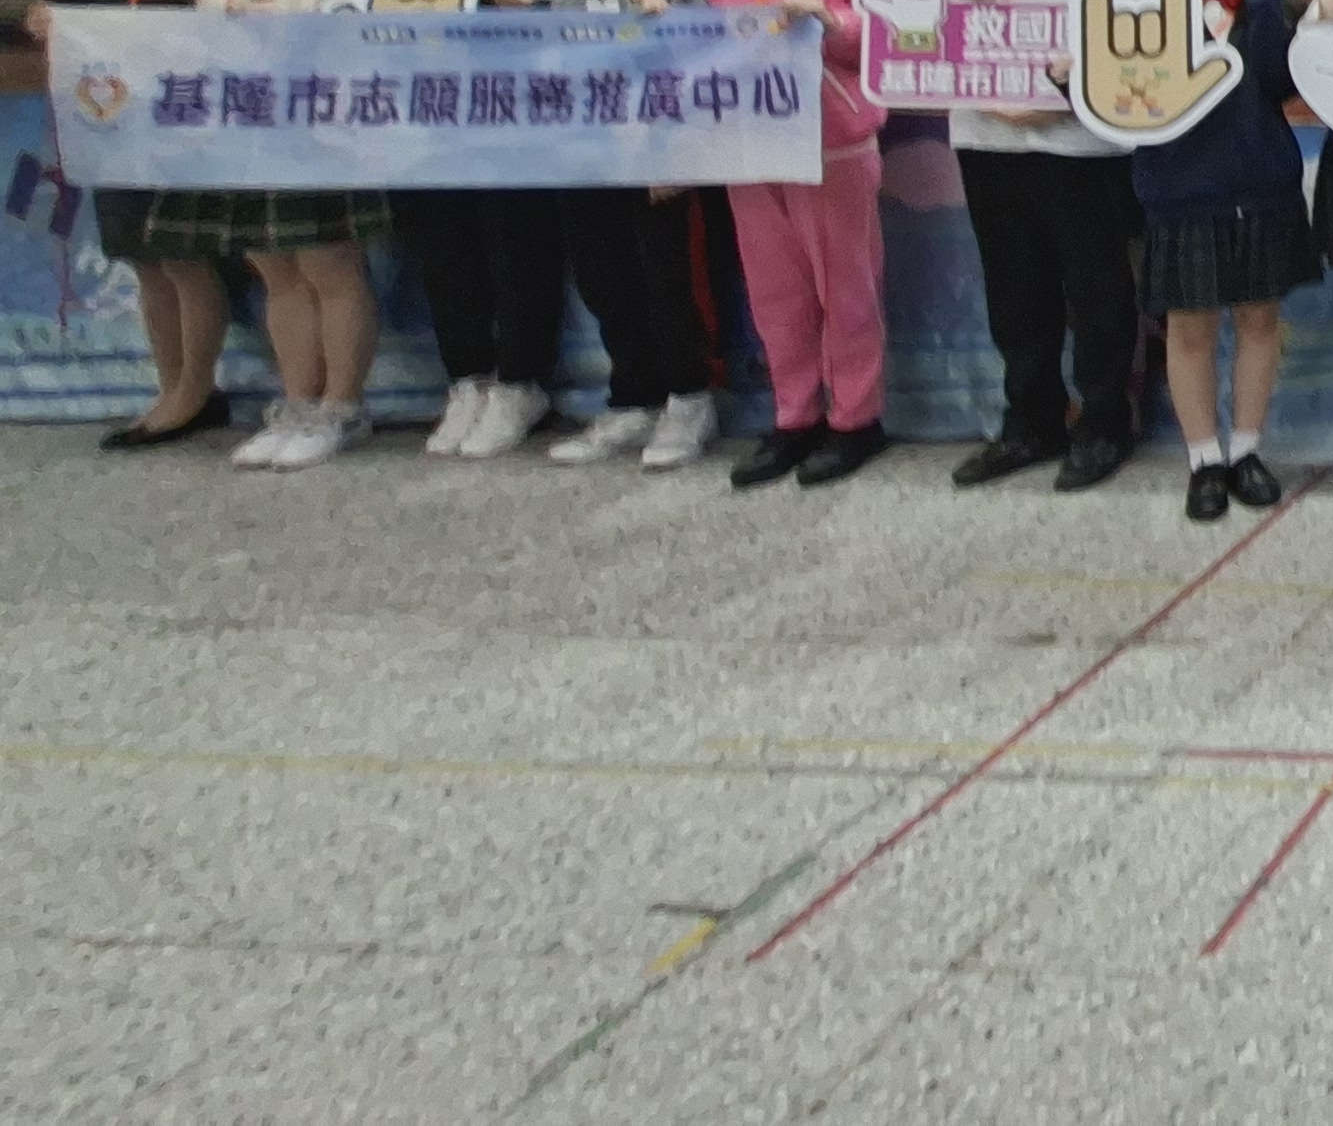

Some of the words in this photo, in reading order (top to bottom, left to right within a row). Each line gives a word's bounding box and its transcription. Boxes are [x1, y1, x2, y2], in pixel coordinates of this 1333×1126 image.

[152, 70, 801, 130] 基隆市志願服務推廣中心
